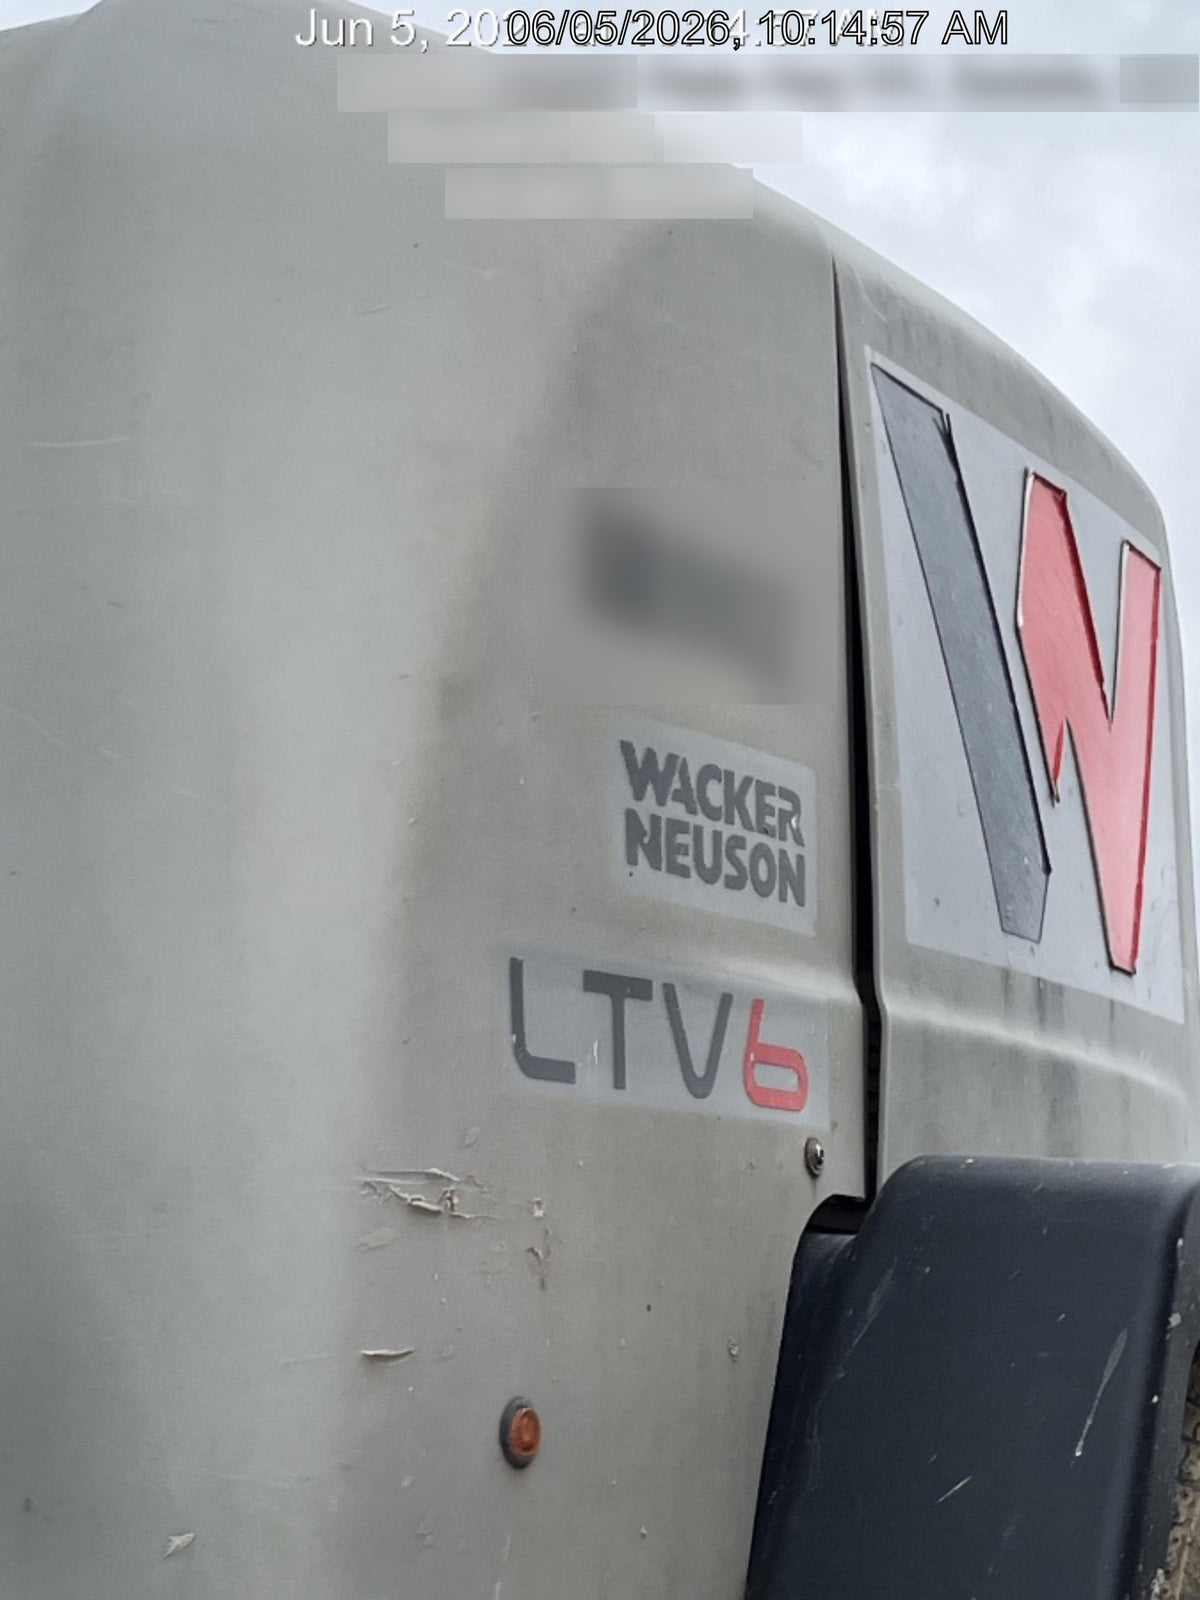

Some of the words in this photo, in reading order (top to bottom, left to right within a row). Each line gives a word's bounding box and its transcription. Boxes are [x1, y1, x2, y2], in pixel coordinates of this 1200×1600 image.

[620, 739, 805, 847] WACKER
[625, 808, 805, 908] NEUSON
[509, 956, 809, 1112] LTV6
